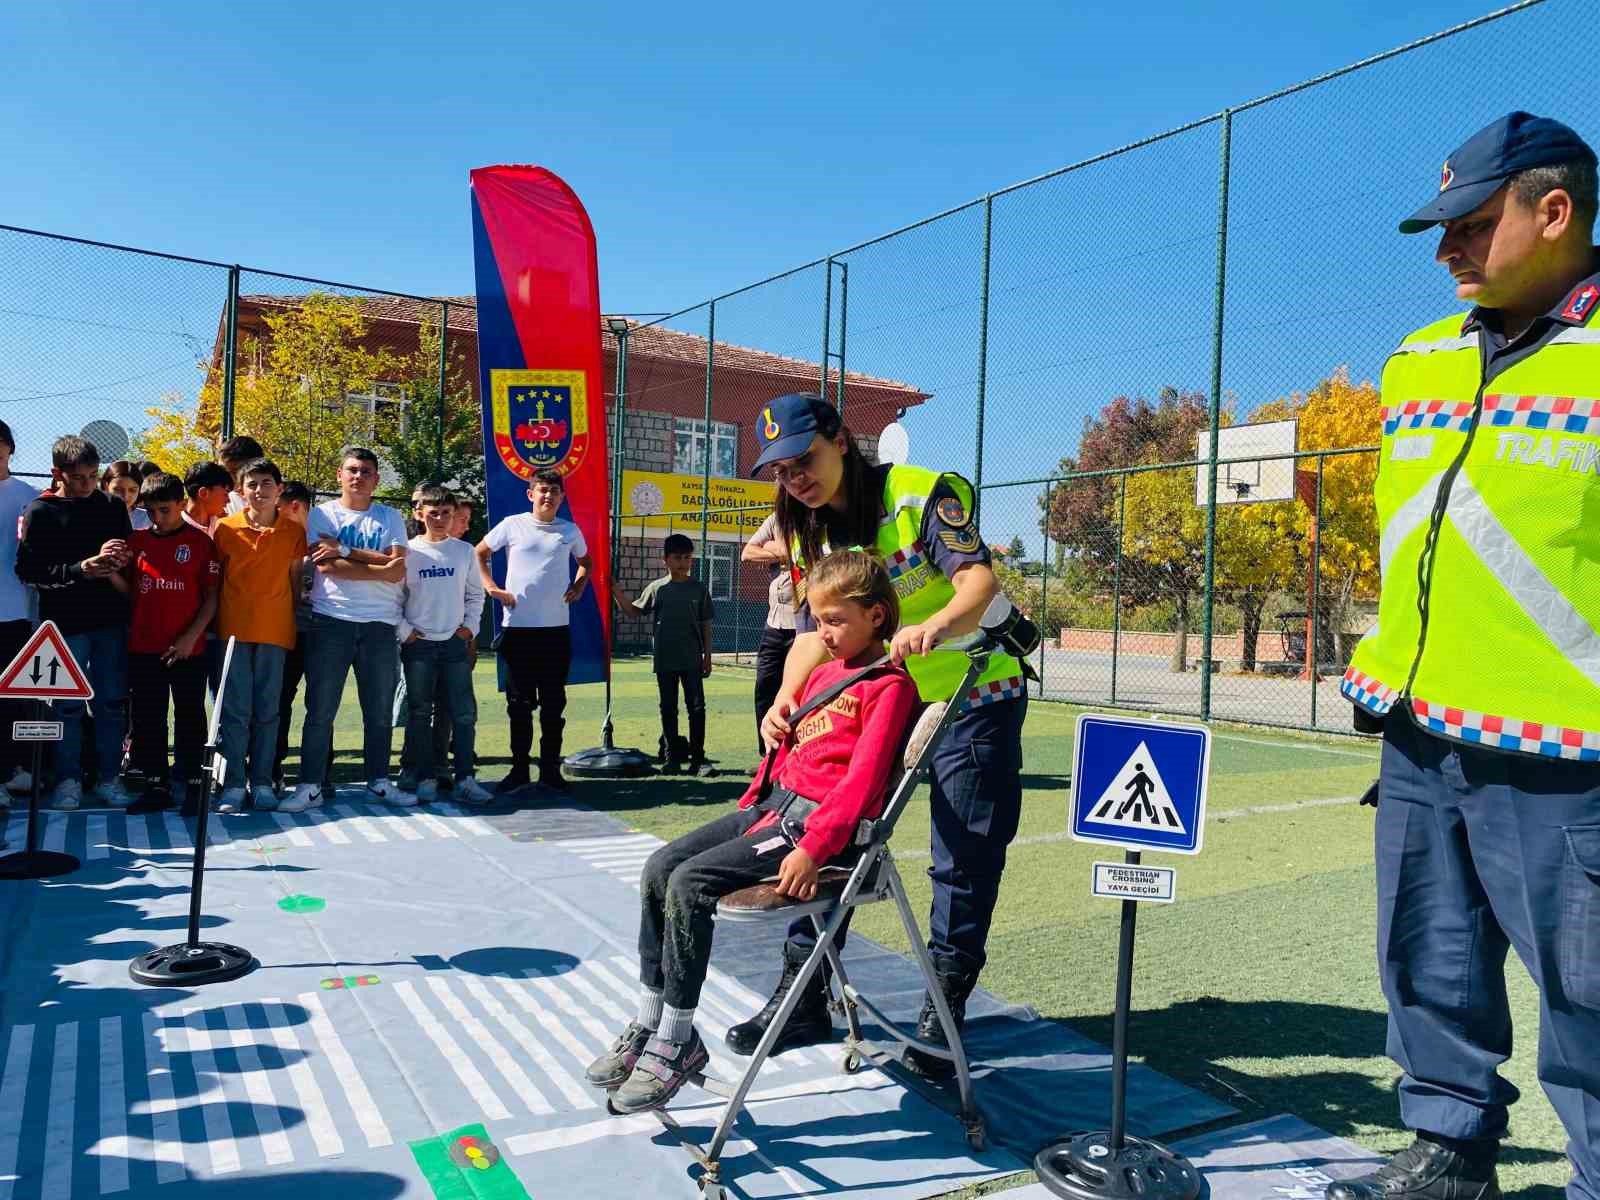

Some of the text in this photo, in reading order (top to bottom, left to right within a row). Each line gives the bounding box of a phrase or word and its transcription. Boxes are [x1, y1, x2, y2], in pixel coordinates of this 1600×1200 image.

[418, 565, 455, 578] miav
[1107, 869, 1160, 878] PEDESTRIAN
[1112, 875, 1155, 884] CROSSING
[1107, 884, 1160, 895] YAYA GEÇİDİ
